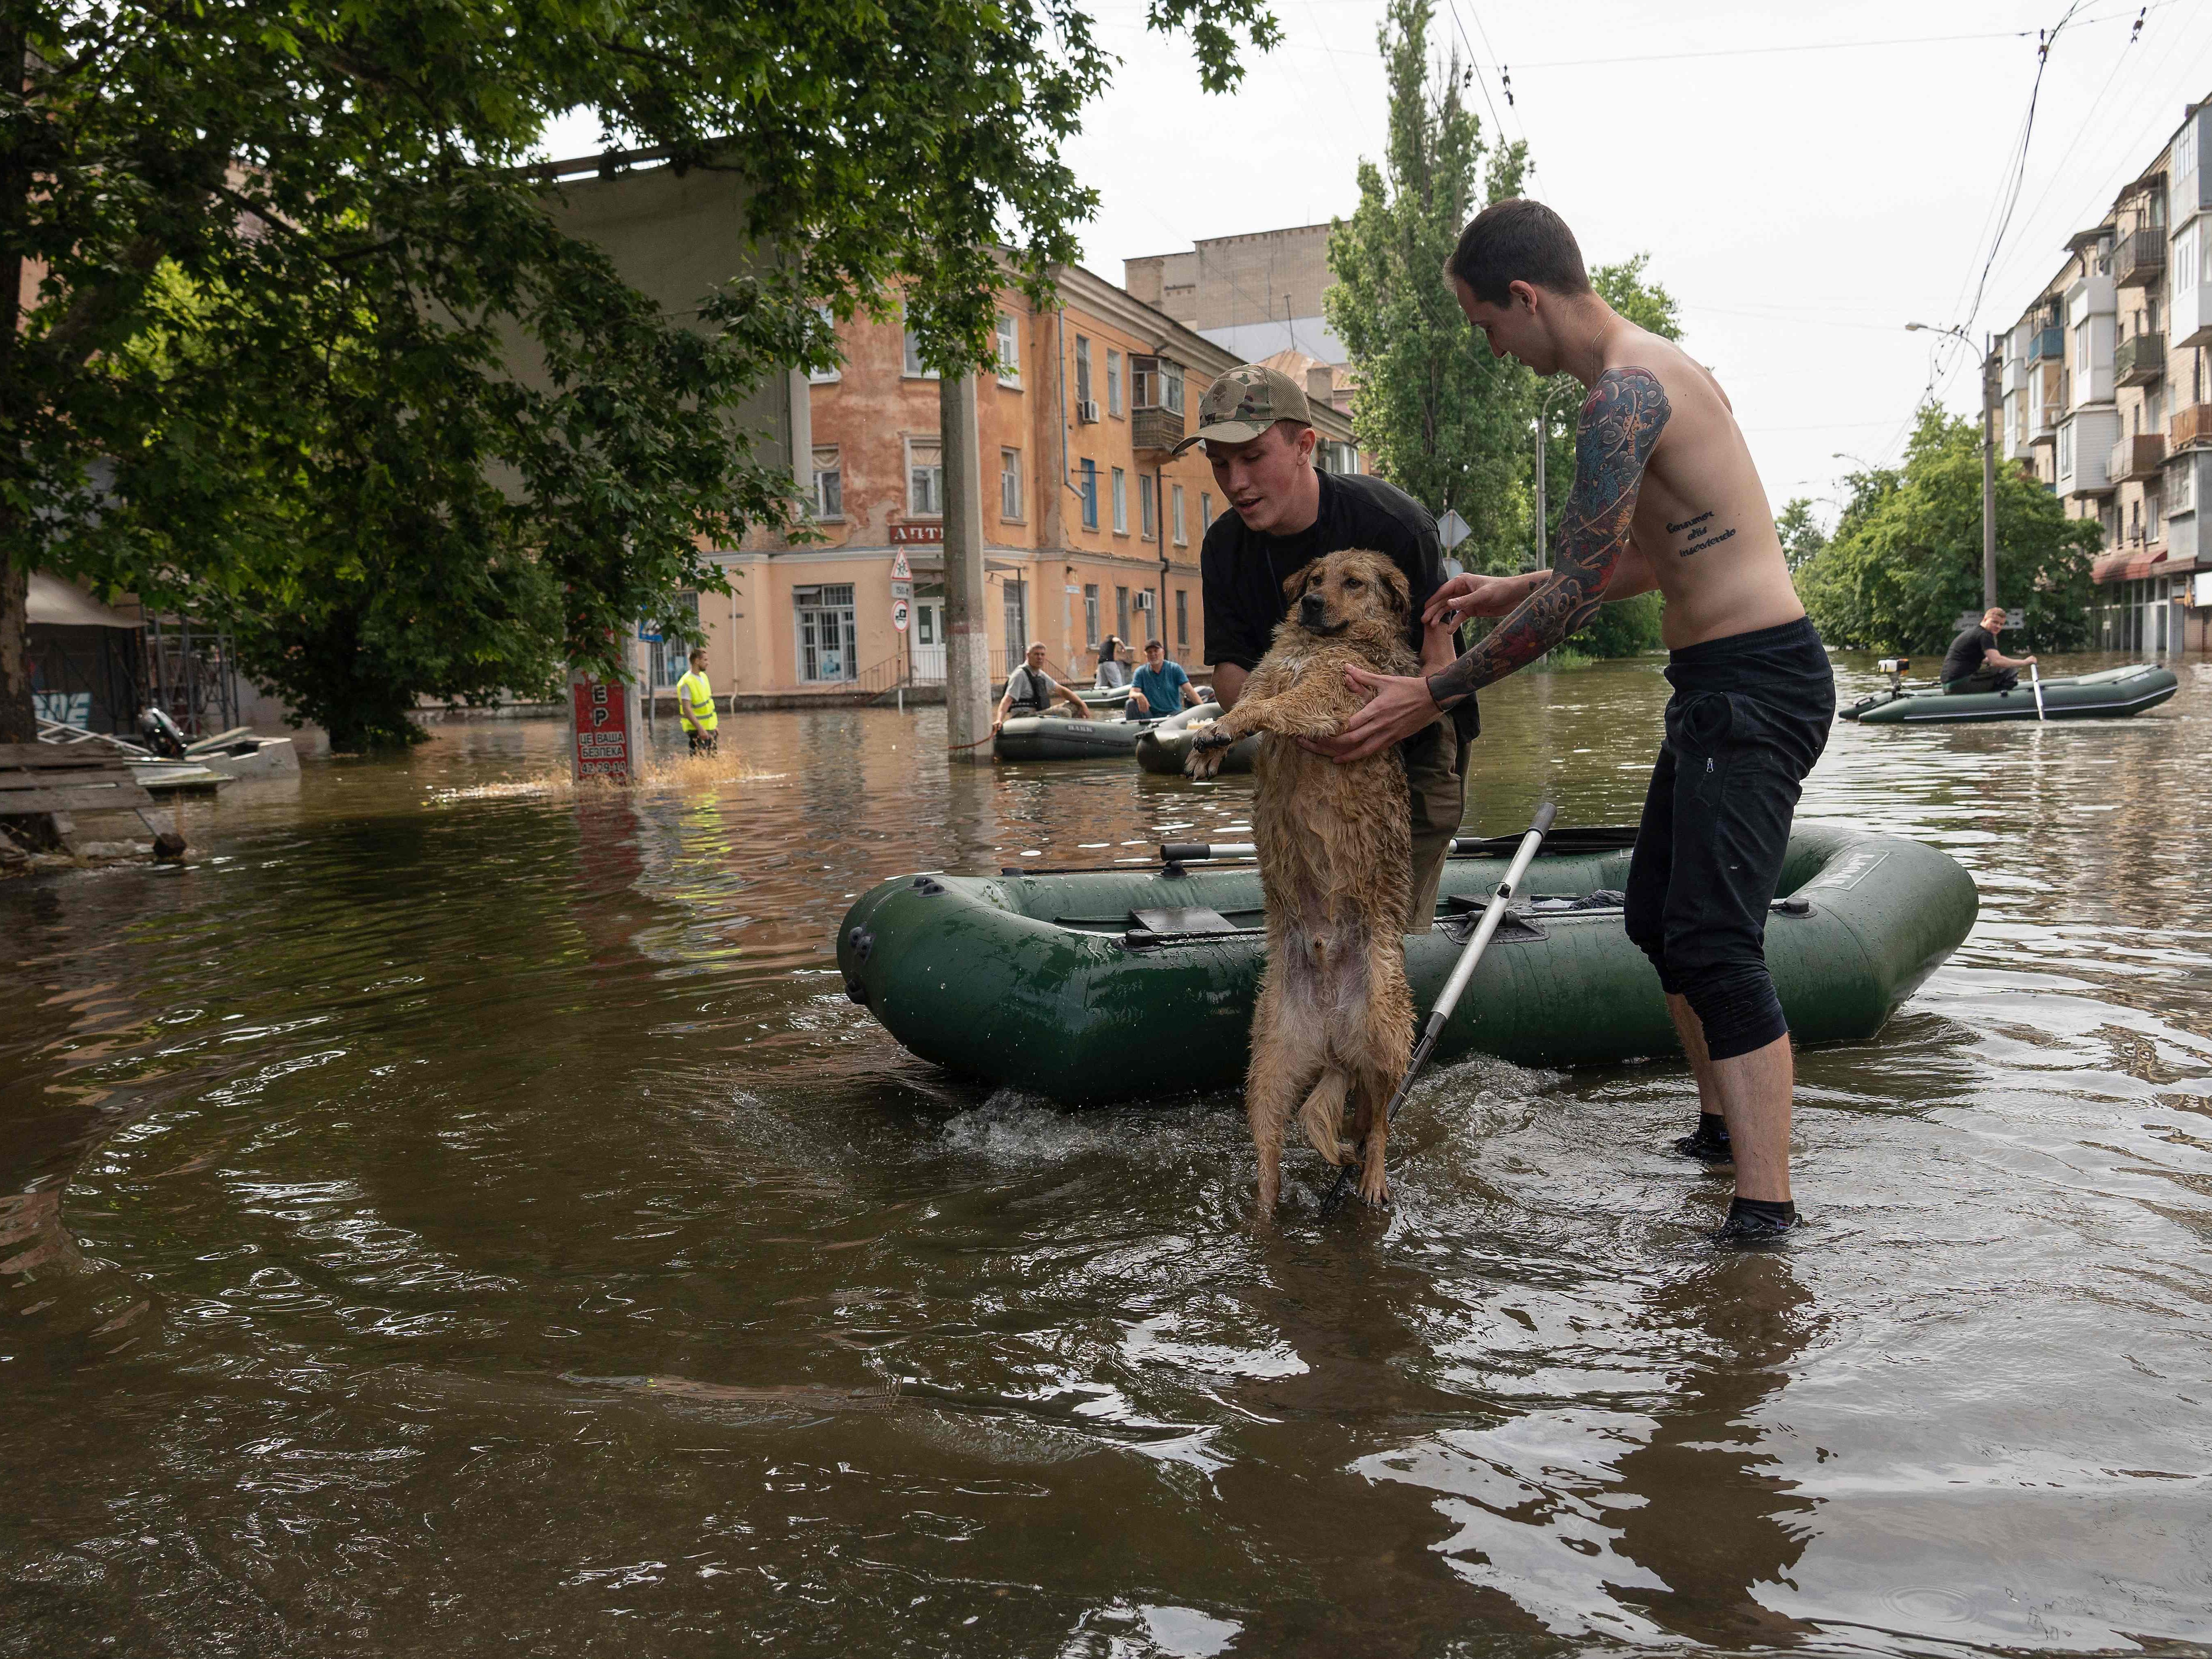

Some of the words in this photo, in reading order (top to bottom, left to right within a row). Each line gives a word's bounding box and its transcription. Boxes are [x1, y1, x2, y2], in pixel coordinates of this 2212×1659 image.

[580, 734, 592, 744] ЦЕ
[597, 733, 623, 743] ВАША
[582, 747, 623, 757] БЕЗПЕКА
